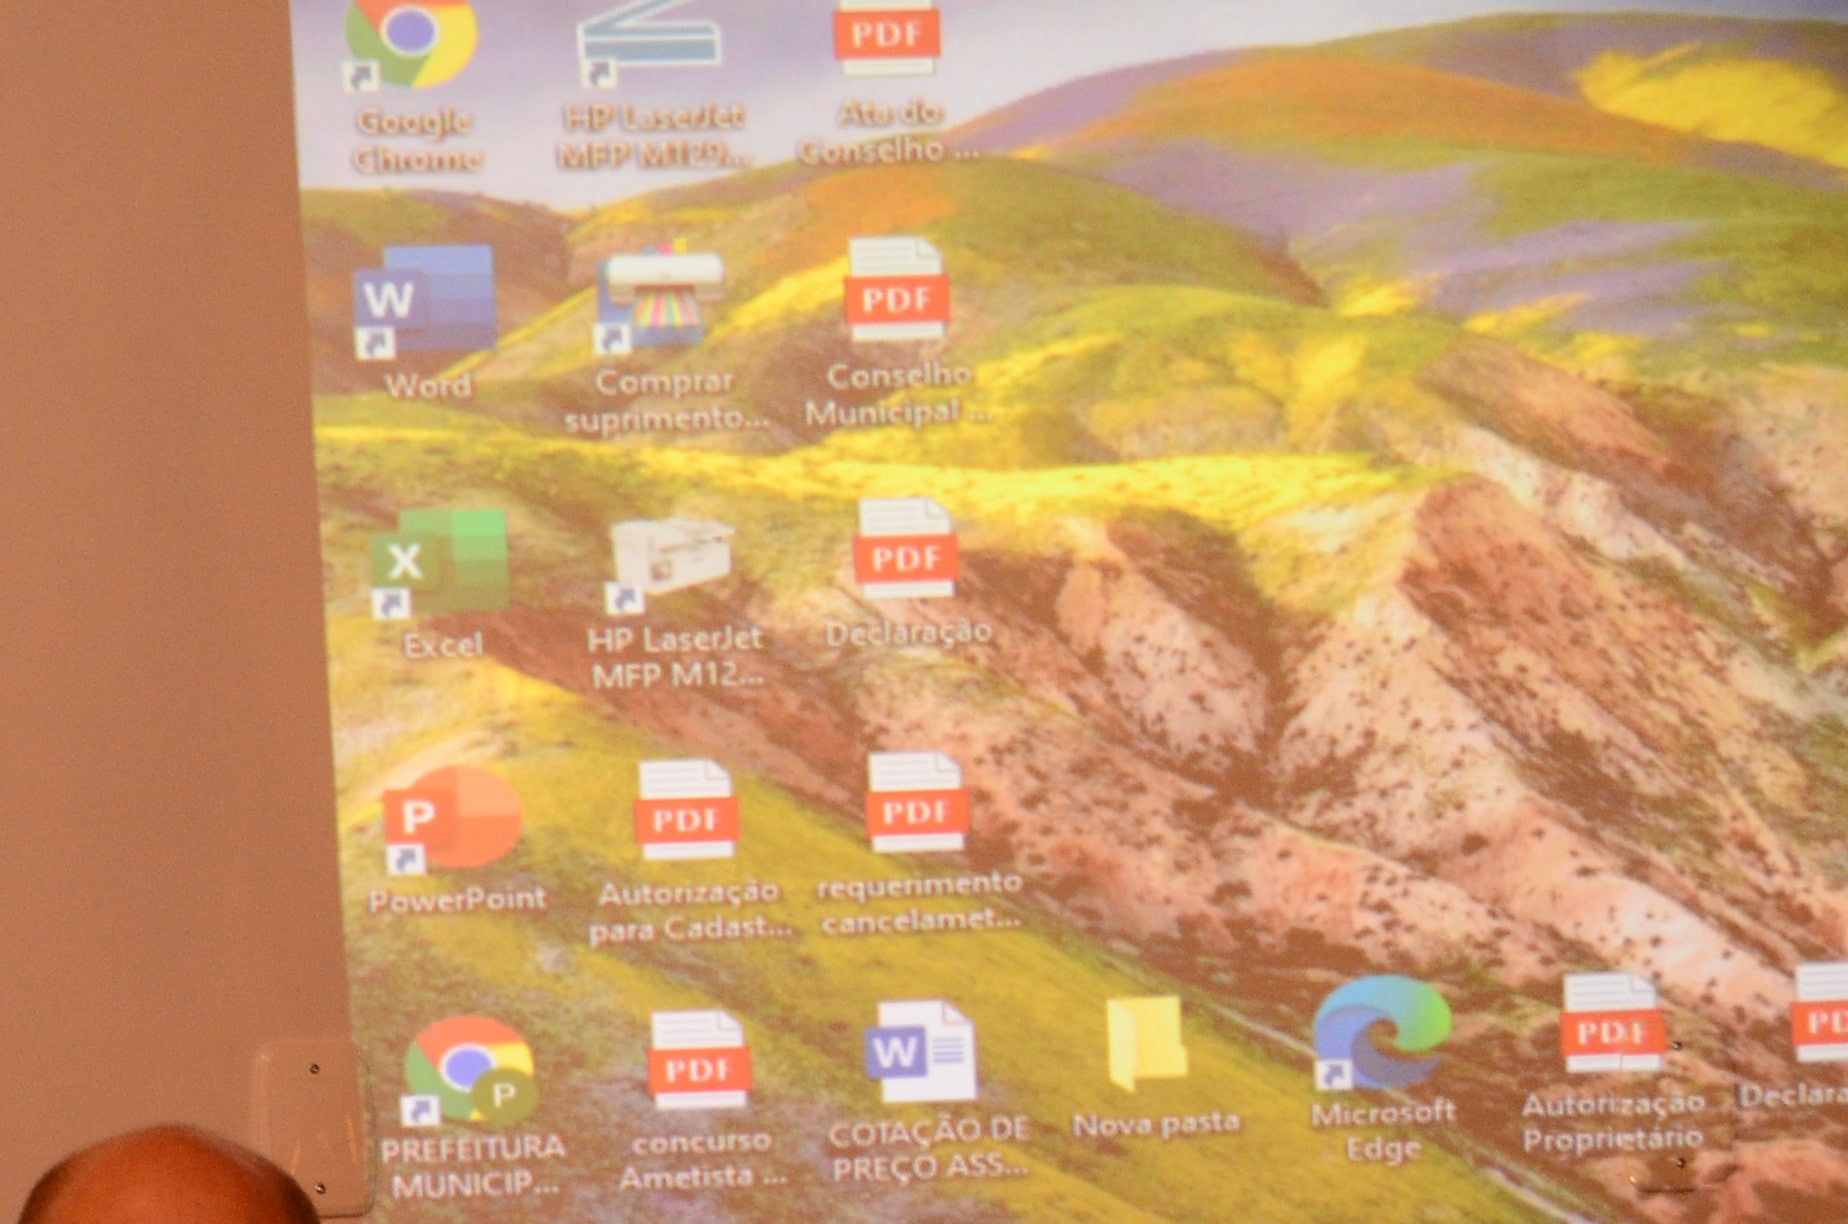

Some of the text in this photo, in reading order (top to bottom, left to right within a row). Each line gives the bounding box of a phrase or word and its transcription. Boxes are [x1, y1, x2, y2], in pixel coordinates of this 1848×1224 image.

[852, 20, 924, 47] PDF
[358, 106, 474, 140] Google
[564, 102, 746, 132] HP LaserJet
[839, 97, 945, 126] Ata do
[353, 145, 485, 173] Chrome
[557, 142, 631, 170] MFP
[798, 136, 944, 165] Conselho
[364, 280, 414, 318] W
[862, 286, 933, 314] PDF
[385, 371, 471, 399] Word
[596, 367, 735, 399] Comprar
[827, 361, 973, 390] Conselho
[805, 398, 960, 428] Municipal
[386, 543, 422, 579] X
[872, 546, 943, 574] PDF
[403, 630, 483, 659] Excel
[587, 625, 763, 654] HP LaserJet
[825, 618, 994, 649] Declaração
[592, 664, 662, 689] MFP
[402, 800, 436, 833] P
[652, 806, 722, 833] PDF
[882, 800, 949, 826] PDF
[369, 887, 547, 914] PowerPoint
[598, 879, 780, 908] Autorização
[817, 870, 1023, 902] requerimento
[588, 922, 655, 947] para
[1576, 1020, 1647, 1046] PDF
[871, 1036, 920, 1070] W
[665, 1057, 734, 1084] PDF
[1311, 1098, 1456, 1127] Microsoft
[1521, 1091, 1707, 1120] Autorização
[829, 1112, 1031, 1151] COTAÇÃO DE
[1071, 1109, 1241, 1141] Nova pasta
[1523, 1123, 1704, 1156] Proprietário
[381, 1133, 566, 1164] PREFEITURA
[632, 1131, 772, 1155] concurso
[1346, 1135, 1422, 1164] Edge
[619, 1163, 754, 1192] Ametista
[832, 1156, 938, 1186] PREÇO
